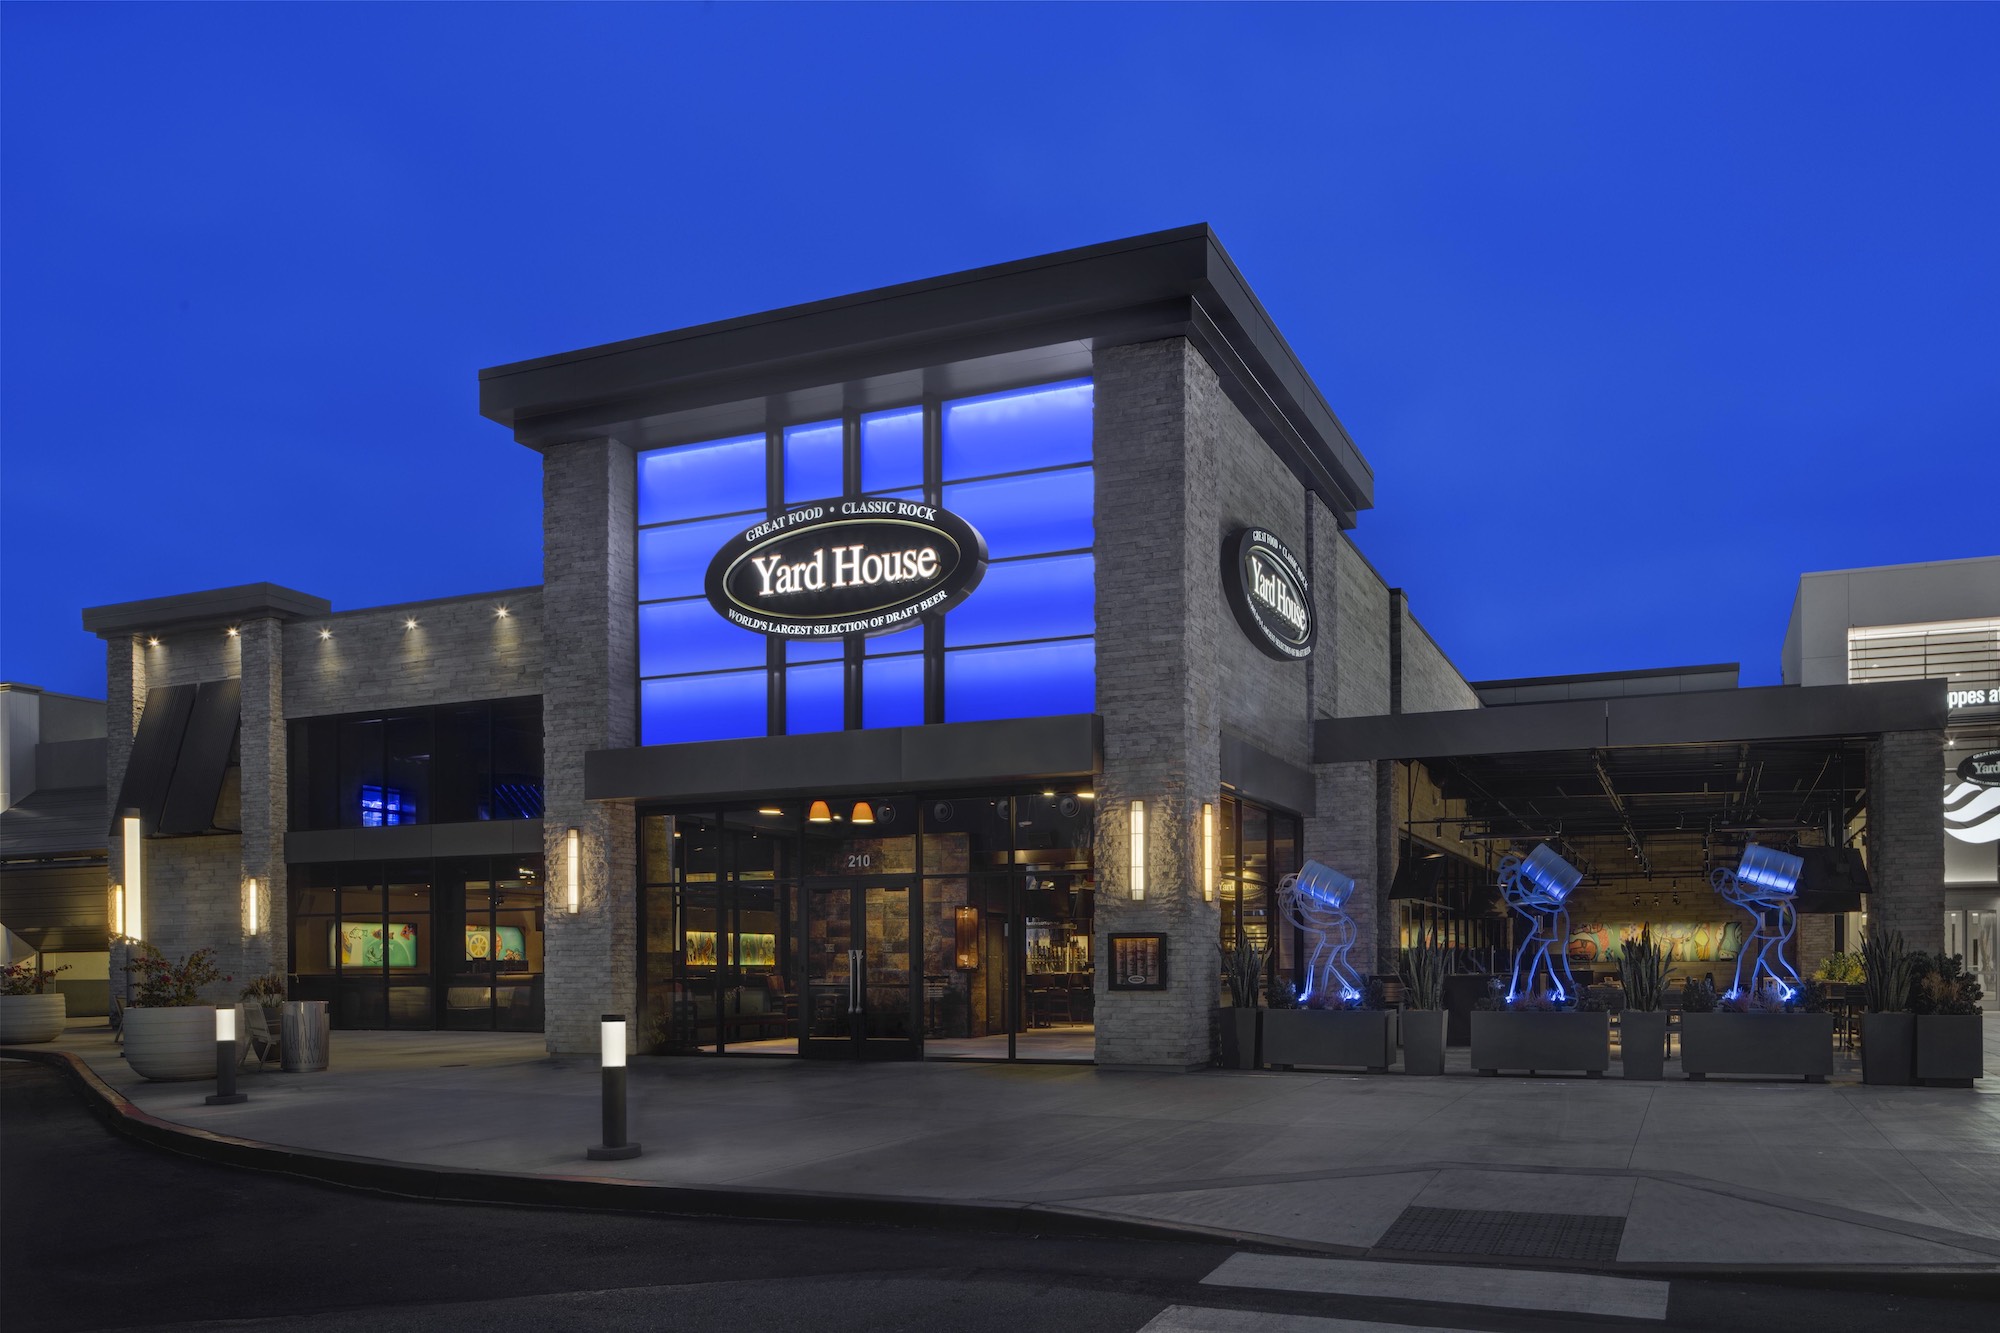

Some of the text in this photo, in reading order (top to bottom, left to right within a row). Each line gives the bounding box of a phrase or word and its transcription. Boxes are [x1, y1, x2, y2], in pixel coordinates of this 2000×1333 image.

[745, 501, 937, 543] GREAT FOOD CLASSIC ROCK
[751, 543, 940, 596] Yard House
[727, 590, 948, 635] WORLD'S LARGEST SELECTION OF DRAFT BEER
[1251, 555, 1276, 607] Yard
[1276, 577, 1306, 631] House
[1946, 689, 1985, 709] ppes
[848, 854, 870, 868] 210
